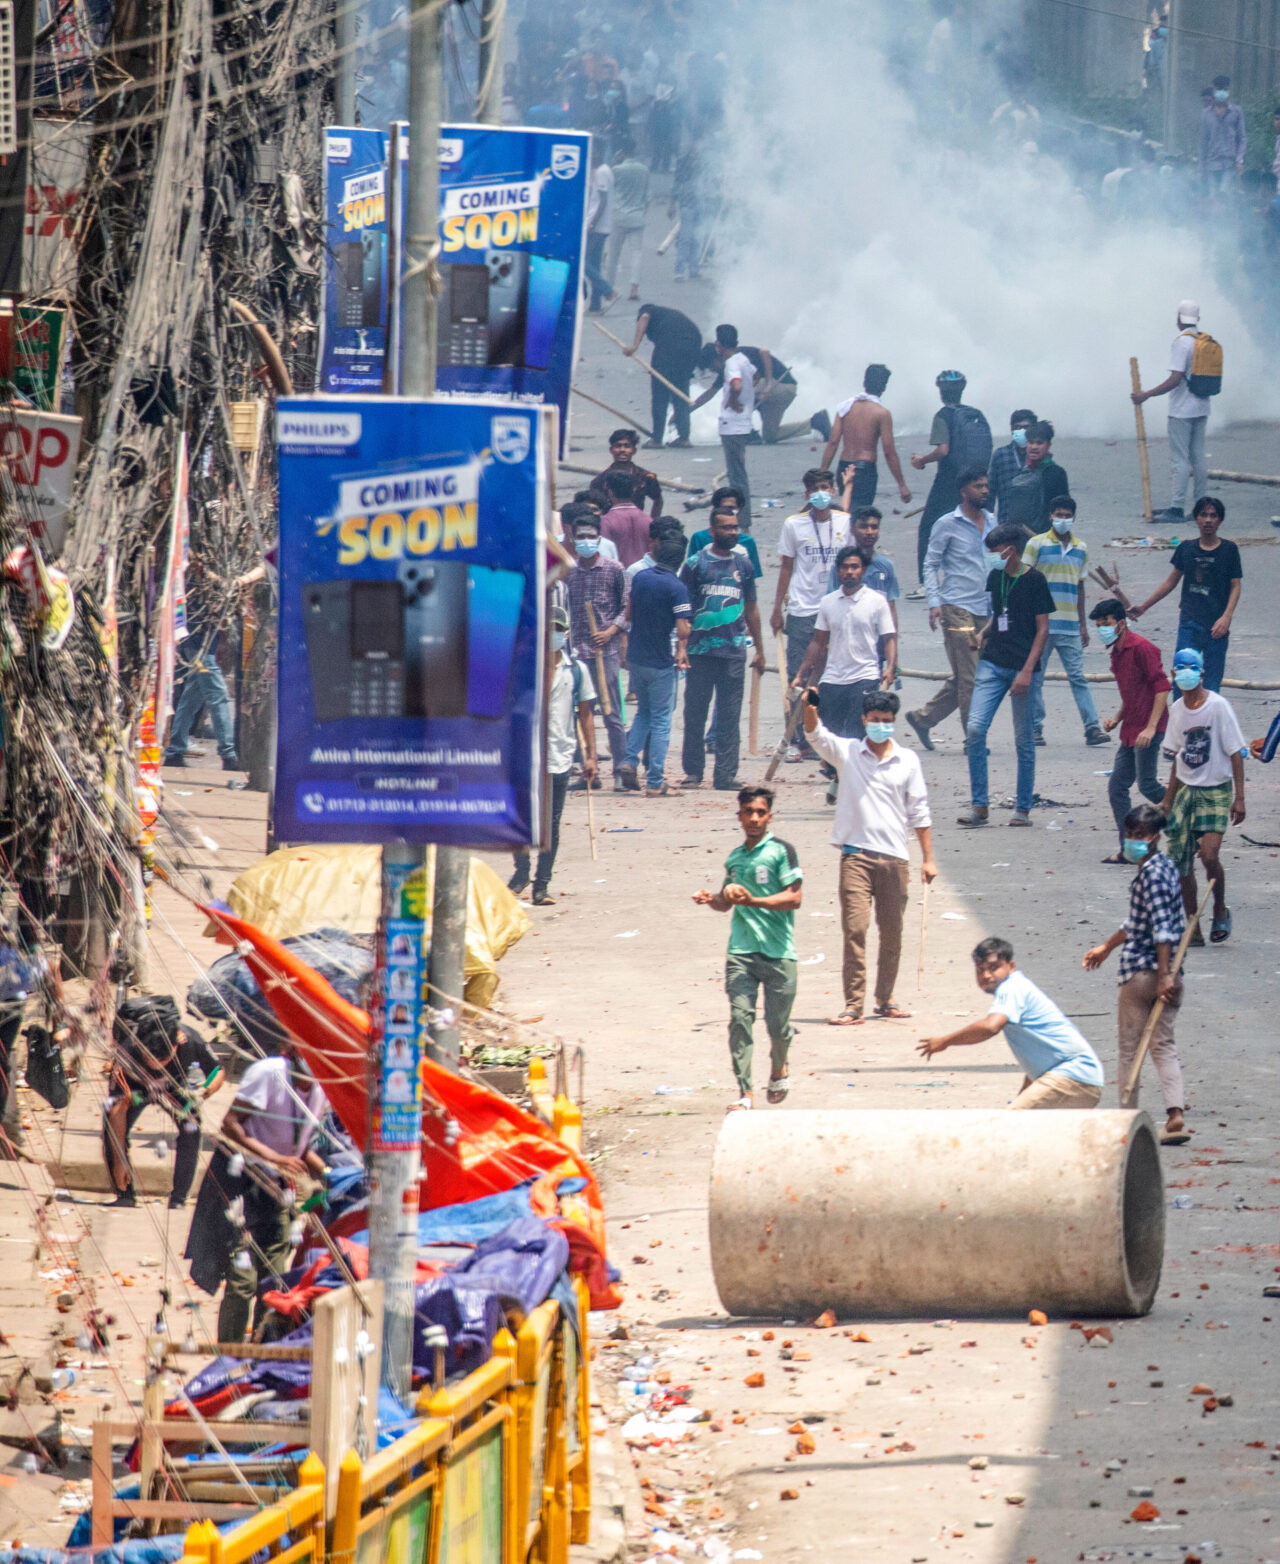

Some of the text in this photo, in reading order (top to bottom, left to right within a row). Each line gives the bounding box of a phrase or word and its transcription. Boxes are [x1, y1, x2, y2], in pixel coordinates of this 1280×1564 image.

[350, 176, 379, 197] COMING
[459, 186, 531, 210] COMING
[343, 193, 385, 232] SOON
[442, 207, 539, 252] SOON
[283, 423, 350, 438] PHILIPS
[359, 474, 457, 508] COMING
[337, 501, 478, 565] SOON
[353, 748, 443, 765] International
[448, 749, 501, 765] Limited
[373, 777, 439, 791] HOTLINE
